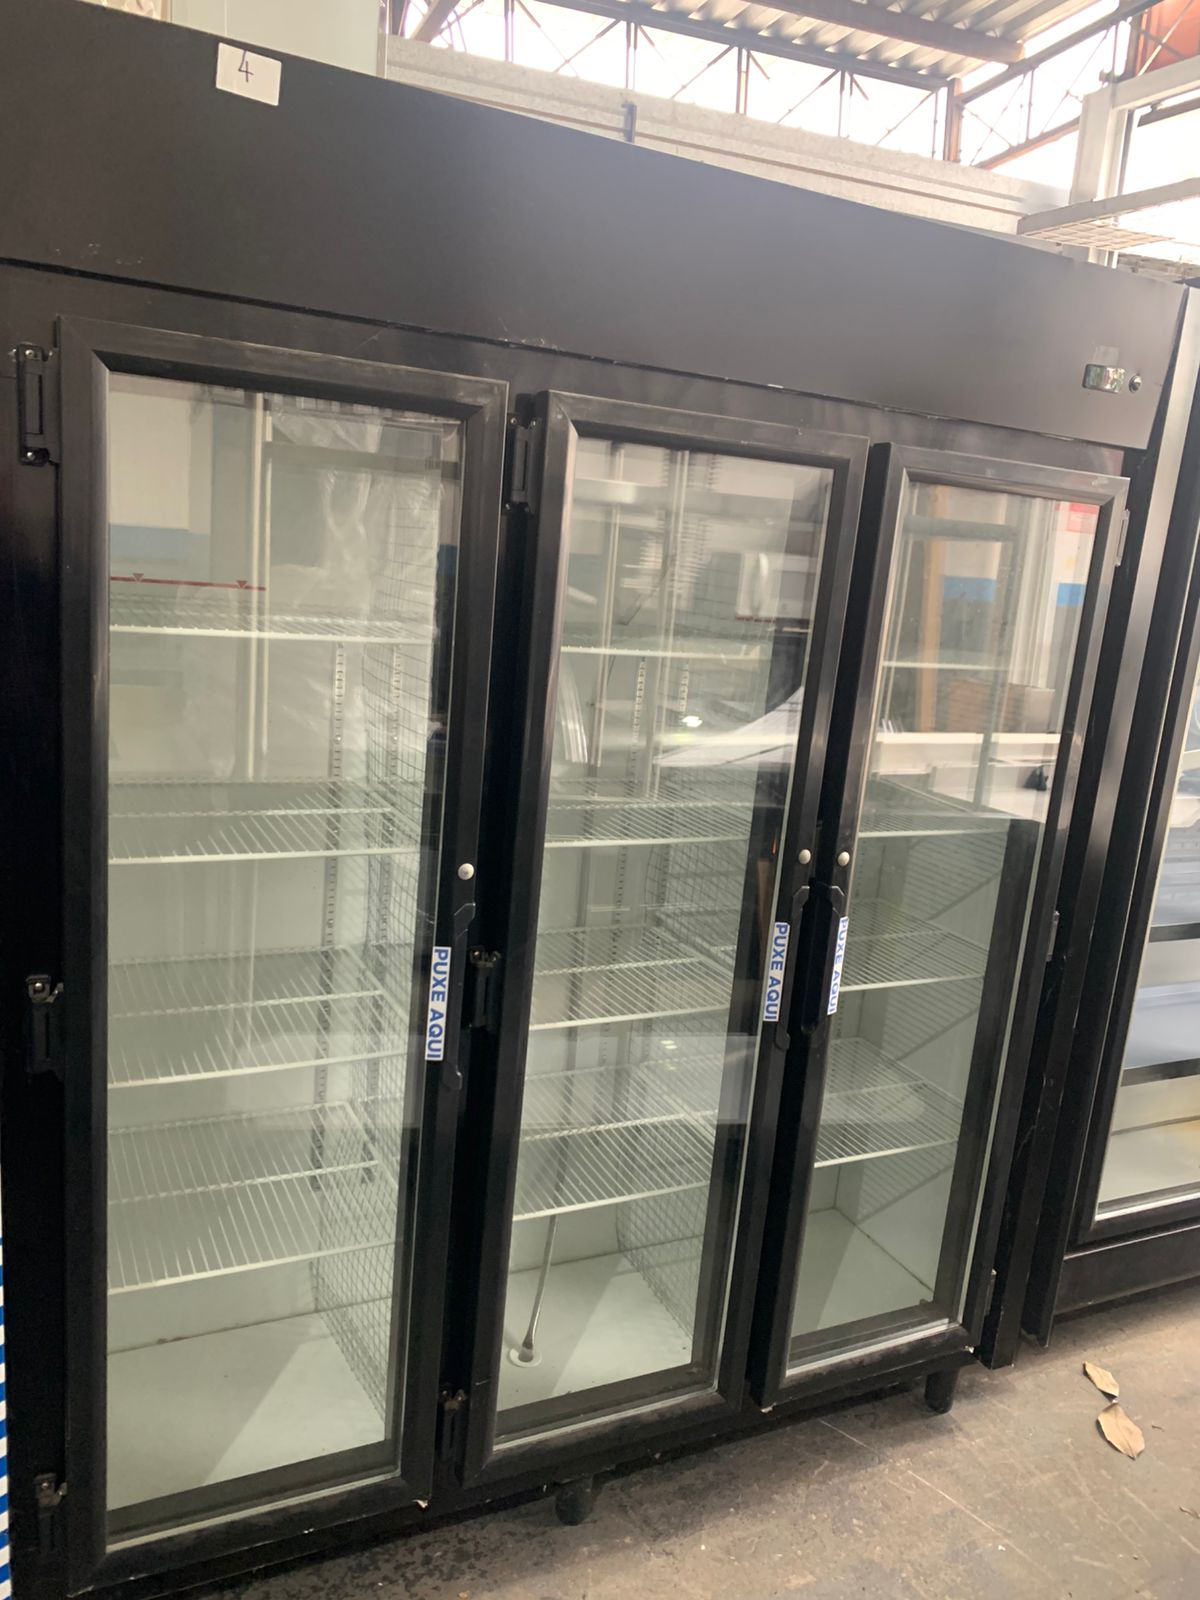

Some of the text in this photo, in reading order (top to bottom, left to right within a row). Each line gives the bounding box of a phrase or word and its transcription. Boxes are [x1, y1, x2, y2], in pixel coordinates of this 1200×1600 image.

[237, 49, 255, 83] 4
[427, 948, 449, 1058] PUXE AQUI
[764, 923, 788, 1020] PUXE AQUI
[829, 919, 848, 1012] PUXE AQUI
